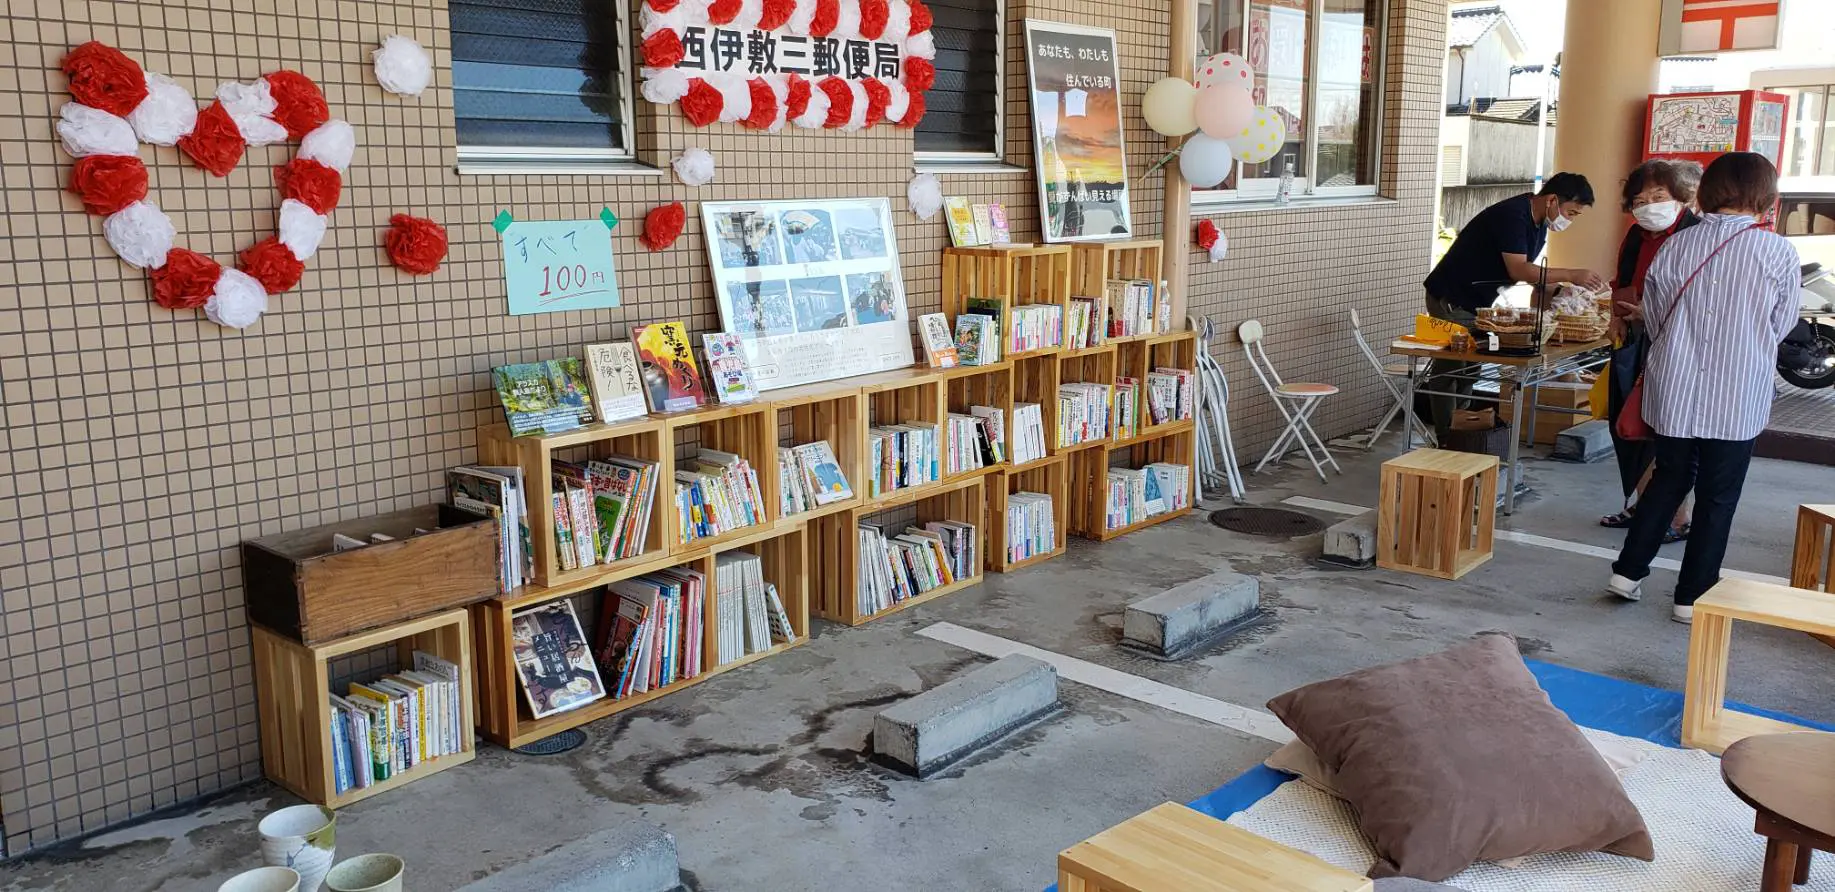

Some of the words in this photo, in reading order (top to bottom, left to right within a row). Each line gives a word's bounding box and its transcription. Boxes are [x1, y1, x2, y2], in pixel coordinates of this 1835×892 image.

[677, 26, 901, 80] 西伊敷三郵便局
[1037, 43, 1110, 62] あなたも、わたしも
[1065, 73, 1112, 89] 住んでいる町
[513, 229, 579, 264] すべて
[538, 263, 606, 297] 100円
[619, 346, 640, 393] 食べるな
